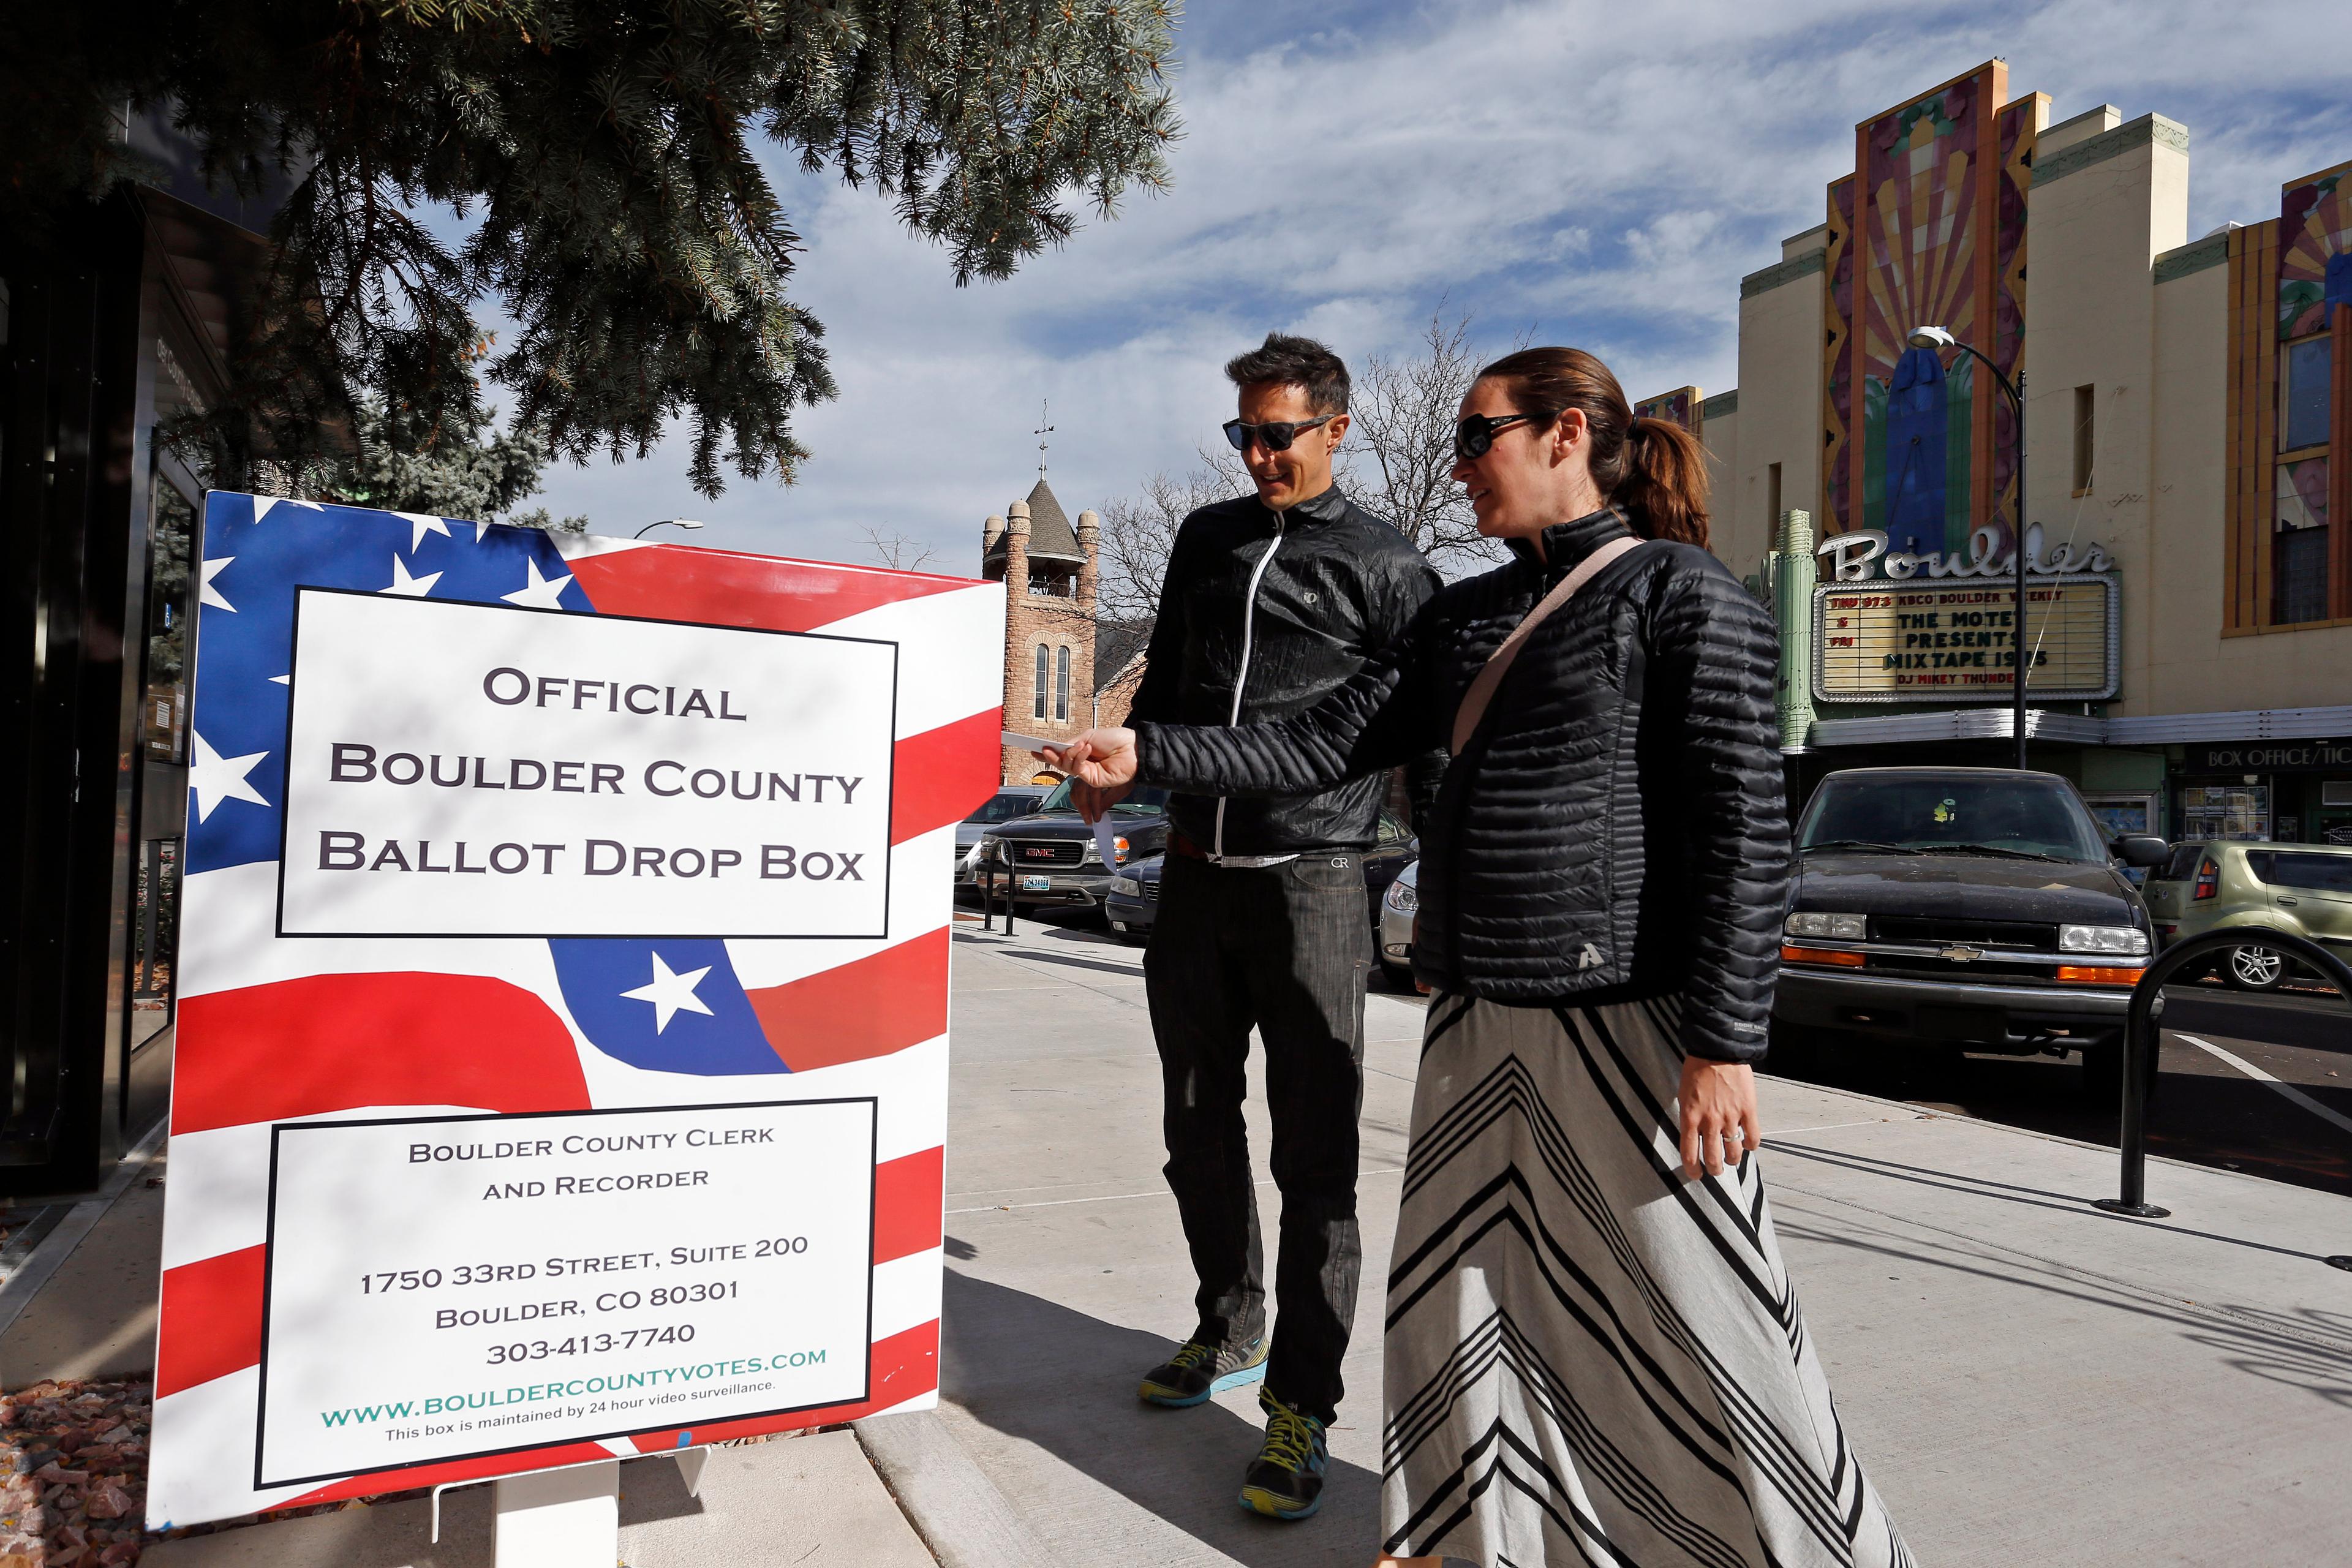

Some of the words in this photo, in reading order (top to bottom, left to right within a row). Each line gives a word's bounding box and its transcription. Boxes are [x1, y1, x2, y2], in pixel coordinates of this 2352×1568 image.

[1817, 521, 2116, 581] Boulder
[1830, 597, 1858, 608] THU
[1899, 594, 1933, 606] KBCO
[1939, 592, 2000, 604] BOULDER
[1898, 613, 1939, 628] THE
[1951, 611, 2027, 627] MOTE
[1830, 636, 1854, 647] FRI
[484, 667, 747, 721] OFFICIAL
[1899, 674, 1913, 684] DJ
[1918, 674, 1956, 685] MIKEY
[1962, 673, 2015, 684] THUNDE
[329, 743, 625, 794] BOULDER
[644, 761, 863, 804] COUNTY
[2208, 750, 2242, 766] BOX
[318, 831, 565, 875] BALLOT
[584, 840, 742, 878] DROP
[760, 845, 864, 881] BOX
[1025, 848, 1055, 857] GMC
[409, 1140, 552, 1163] BOULDER
[562, 1134, 677, 1154] COUNTY
[686, 1128, 773, 1147] CLERK
[483, 1182, 545, 1200] AND
[556, 1170, 708, 1195] RECORDER
[361, 1268, 442, 1294] 1750
[452, 1264, 536, 1285] 33RD
[546, 1253, 660, 1276] STREET,
[671, 1245, 746, 1265] SUITE
[755, 1237, 808, 1257] 200
[435, 1300, 586, 1329] BOULDER,
[596, 1291, 641, 1311] CO
[650, 1281, 737, 1306] 80301
[486, 1324, 695, 1365] 303-413-7740
[320, 1349, 826, 1428] WWW.BOULDERCOUNTYVOTES.COM
[385, 1428, 420, 1441] This
[426, 1423, 454, 1436] box
[459, 1420, 472, 1431] is
[478, 1408, 562, 1428] maintained
[567, 1405, 584, 1419] by
[589, 1402, 606, 1414] 24
[611, 1398, 644, 1411] hour
[649, 1392, 686, 1405] video
[691, 1381, 775, 1400] surveillance.
